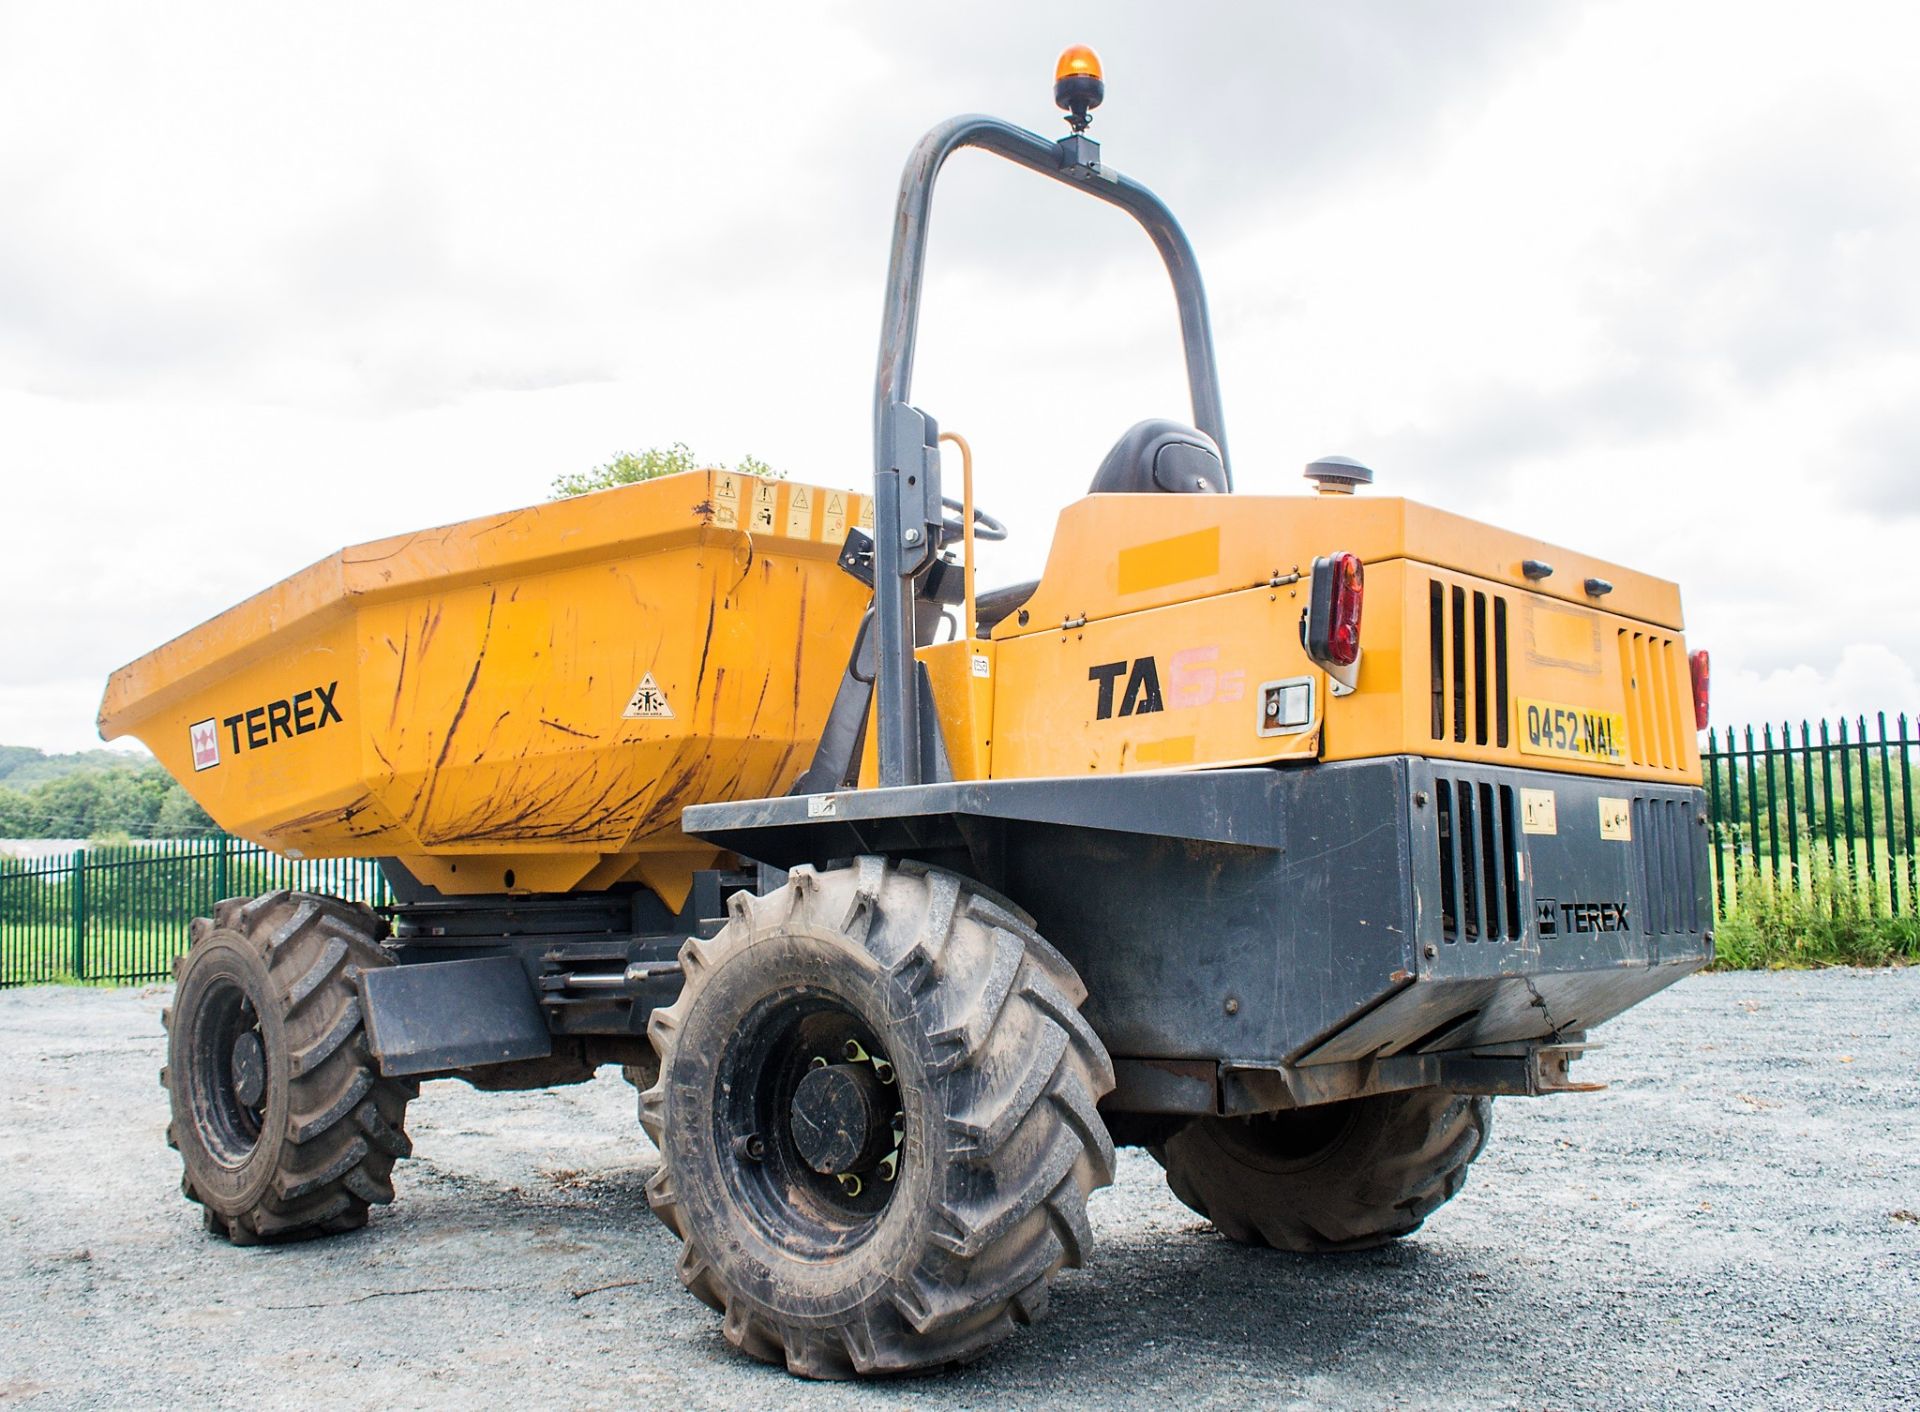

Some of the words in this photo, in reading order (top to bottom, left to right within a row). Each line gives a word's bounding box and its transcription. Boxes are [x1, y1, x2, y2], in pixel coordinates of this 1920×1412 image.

[223, 681, 343, 755] TEREX
[1528, 705, 1580, 751] Q452
[1583, 714, 1619, 756] NAL
[1560, 903, 1630, 933] TEREX
